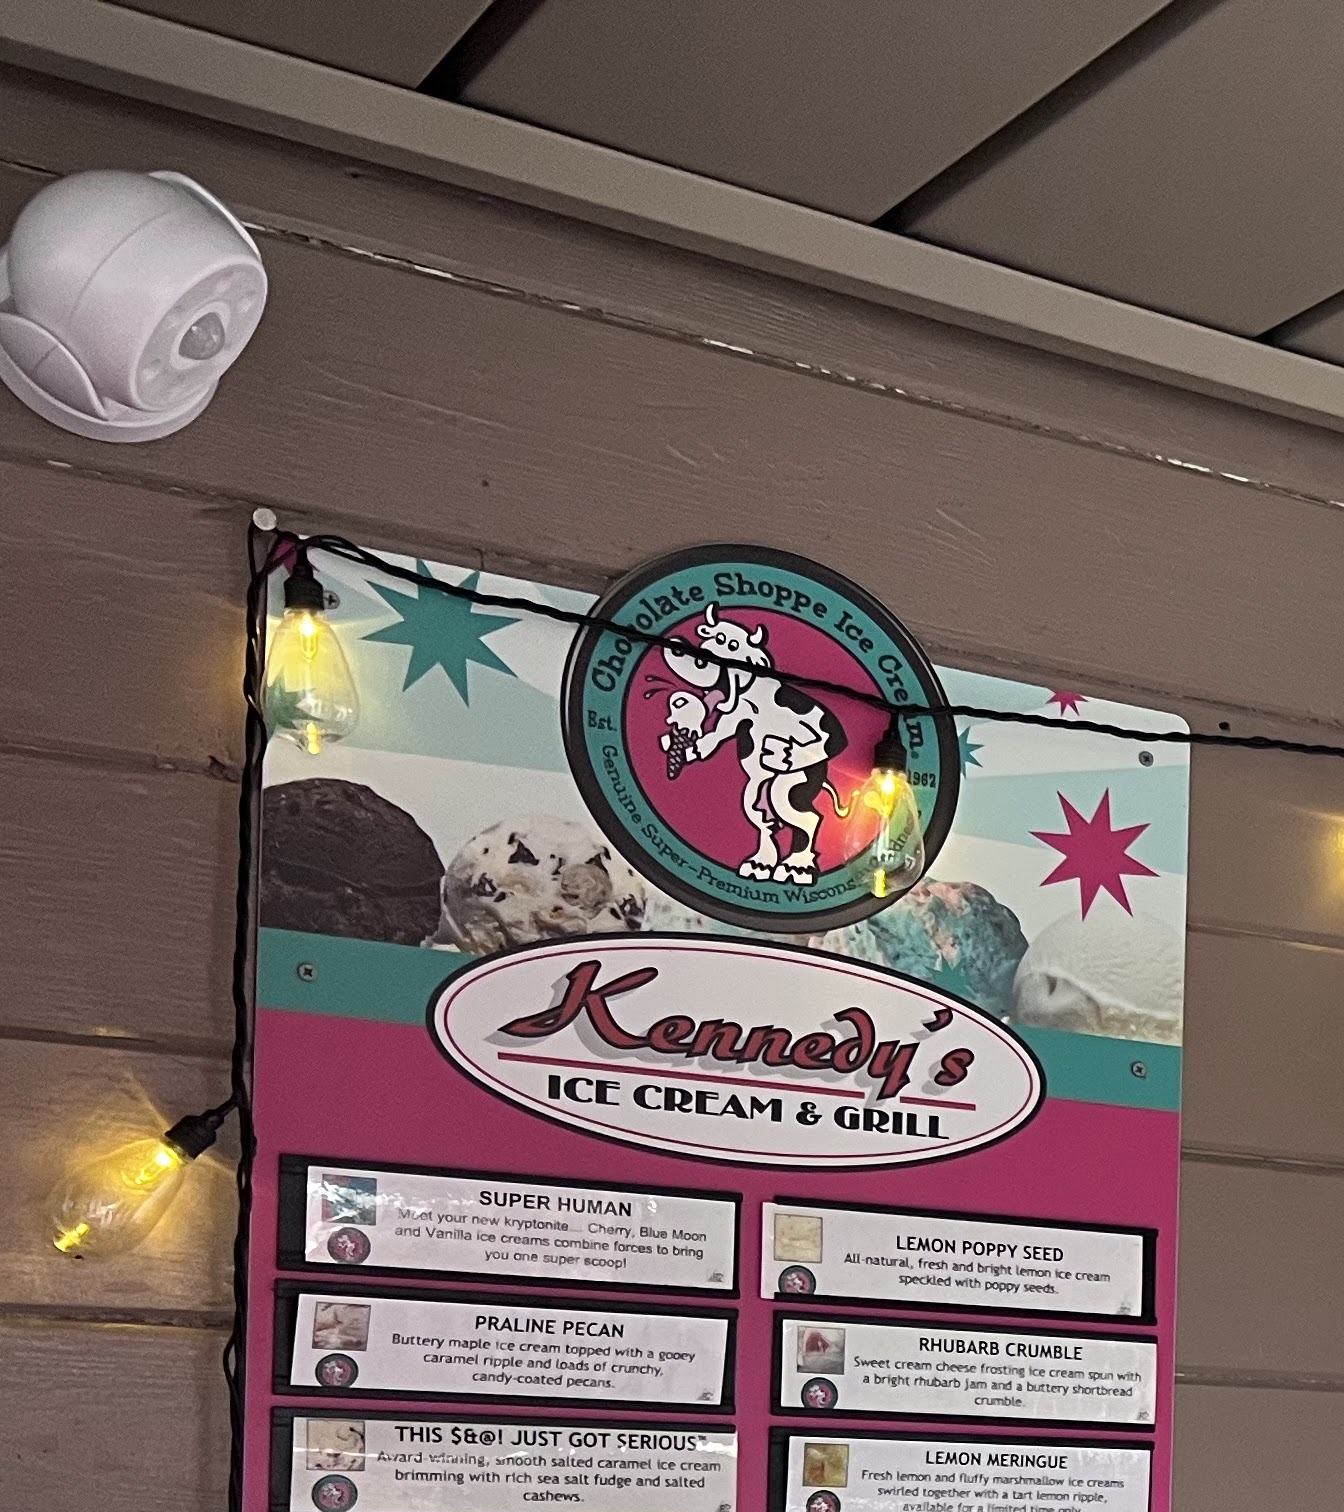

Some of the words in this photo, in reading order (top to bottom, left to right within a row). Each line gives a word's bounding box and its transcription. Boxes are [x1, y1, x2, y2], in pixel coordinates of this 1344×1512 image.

[713, 572, 827, 618] Shoppe
[834, 612, 874, 653] Ice
[602, 745, 642, 825] Genuine
[498, 960, 975, 1100] Kennedy's
[548, 1074, 621, 1106] ICE
[633, 1084, 783, 1123] CREAM
[795, 1101, 823, 1126] &
[833, 1105, 950, 1140] GRILL
[478, 1190, 551, 1211] SUPER
[558, 1196, 632, 1217] HUMAN
[896, 1235, 956, 1254] LEMON
[962, 1240, 1018, 1259] POPPY
[1022, 1245, 1064, 1262] SEED
[475, 1315, 557, 1335] PRALINE
[562, 1320, 625, 1339] PECAN
[919, 1337, 1000, 1356] RHUBARB
[1005, 1342, 1083, 1361] CRUMBLE
[394, 1425, 443, 1444] THIS
[450, 1426, 503, 1446] $&@!
[510, 1429, 563, 1447] JUST
[568, 1431, 611, 1449] GOT
[616, 1430, 709, 1452] SERIOUS™
[925, 1450, 982, 1466] LEMON
[986, 1453, 1068, 1470] MERINGUE
